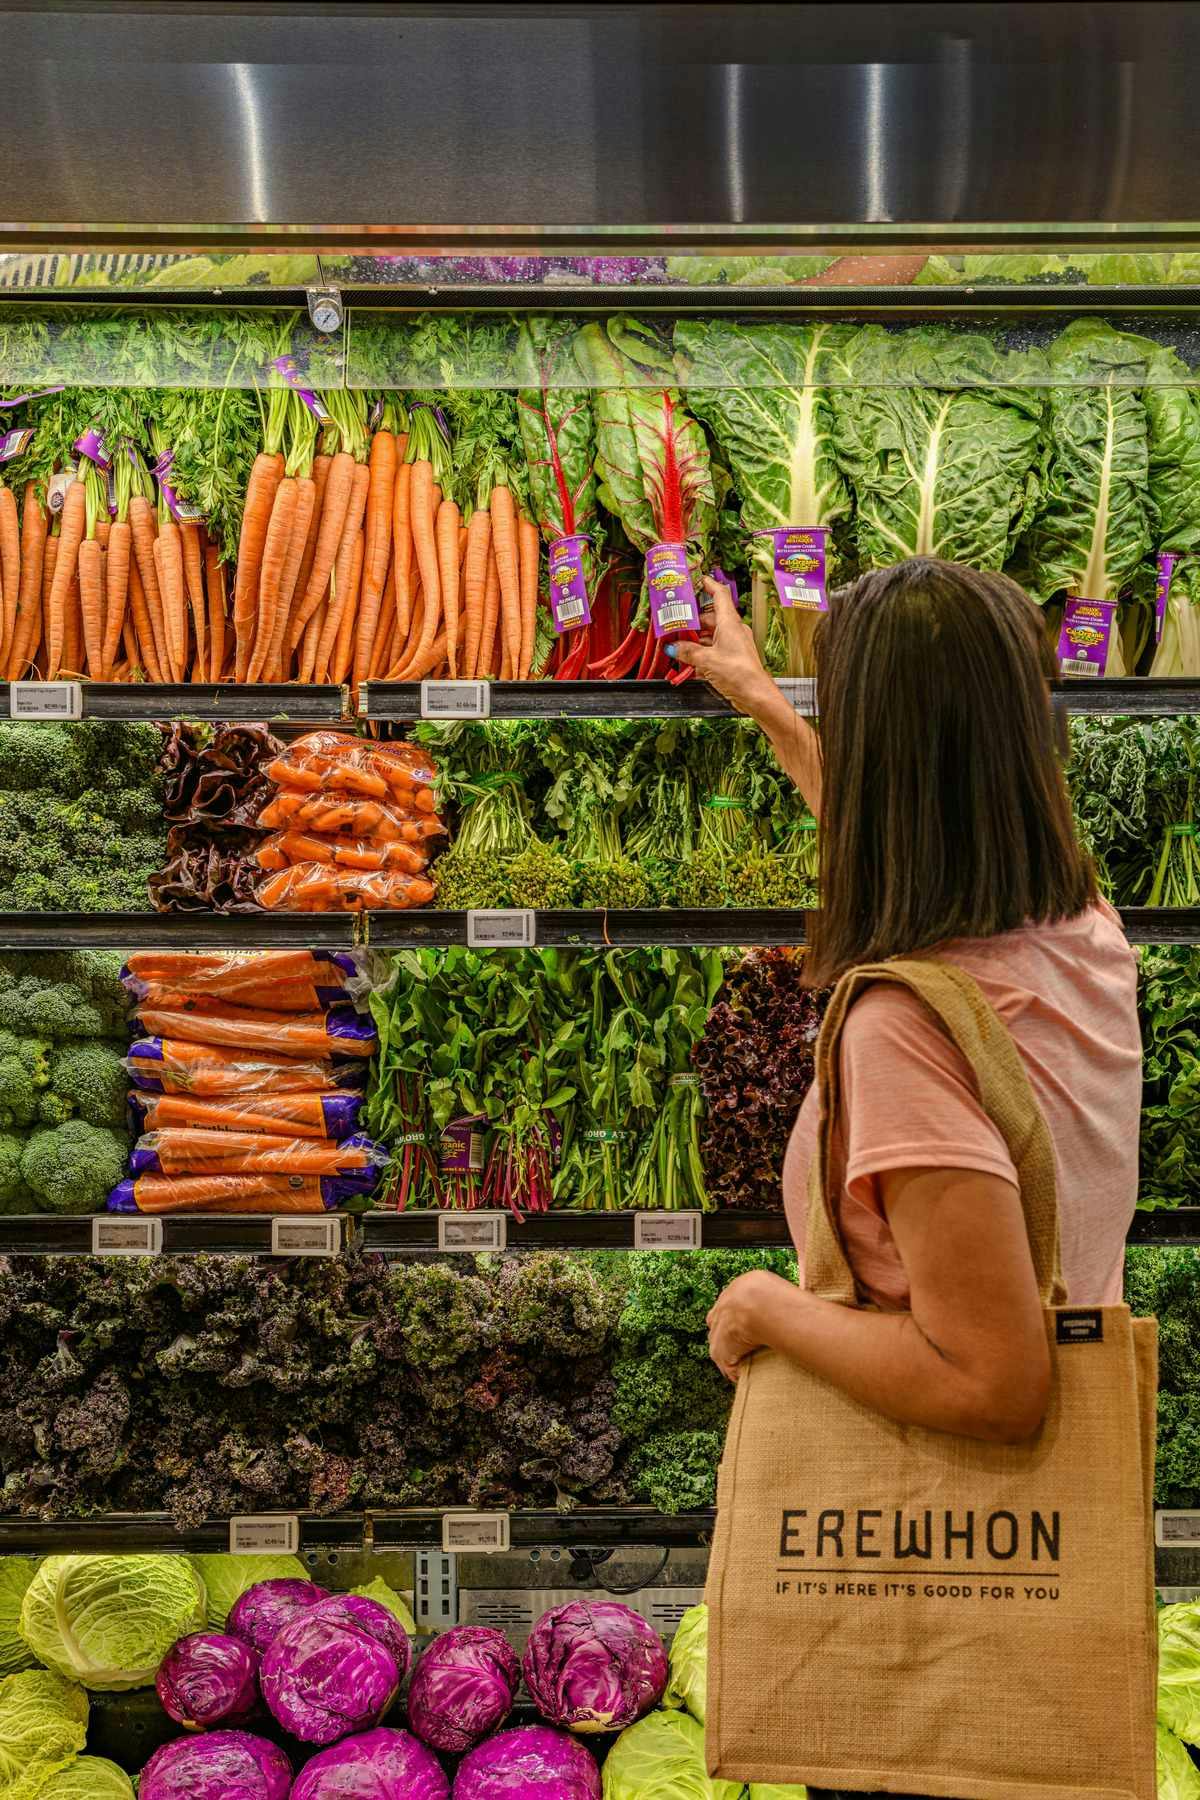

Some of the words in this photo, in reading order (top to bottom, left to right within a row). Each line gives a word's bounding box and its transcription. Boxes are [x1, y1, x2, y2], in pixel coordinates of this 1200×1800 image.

[779, 1509, 1060, 1561] EREWHON
[776, 1582, 790, 1594] IF
[797, 1582, 827, 1595] IT'S
[835, 1583, 877, 1596] HERE
[884, 1583, 916, 1597] IT'S
[923, 1585, 972, 1598] GOOD
[980, 1586, 1014, 1599] FOR
[1024, 1587, 1060, 1600] YOU
